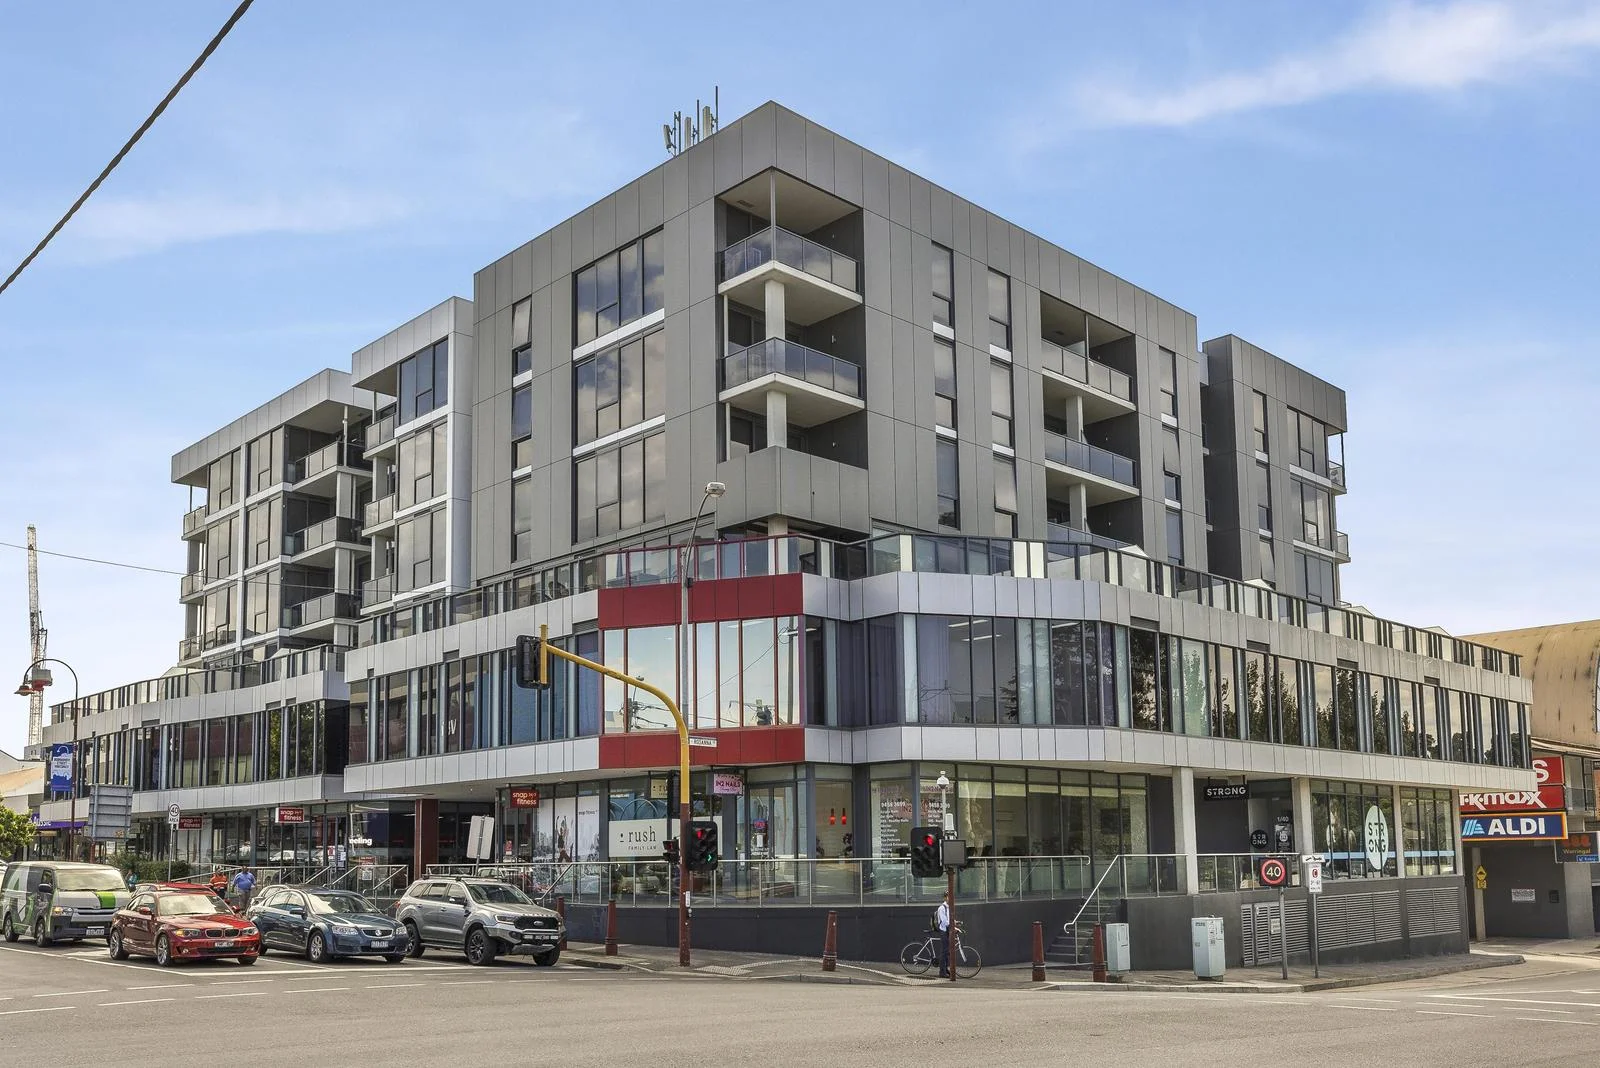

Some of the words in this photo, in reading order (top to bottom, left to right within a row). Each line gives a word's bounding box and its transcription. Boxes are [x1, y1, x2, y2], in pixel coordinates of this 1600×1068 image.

[1206, 786, 1246, 796] STRONG
[1488, 818, 1546, 836] ALDI
[628, 826, 656, 842] rush
[1266, 866, 1282, 877] 40
